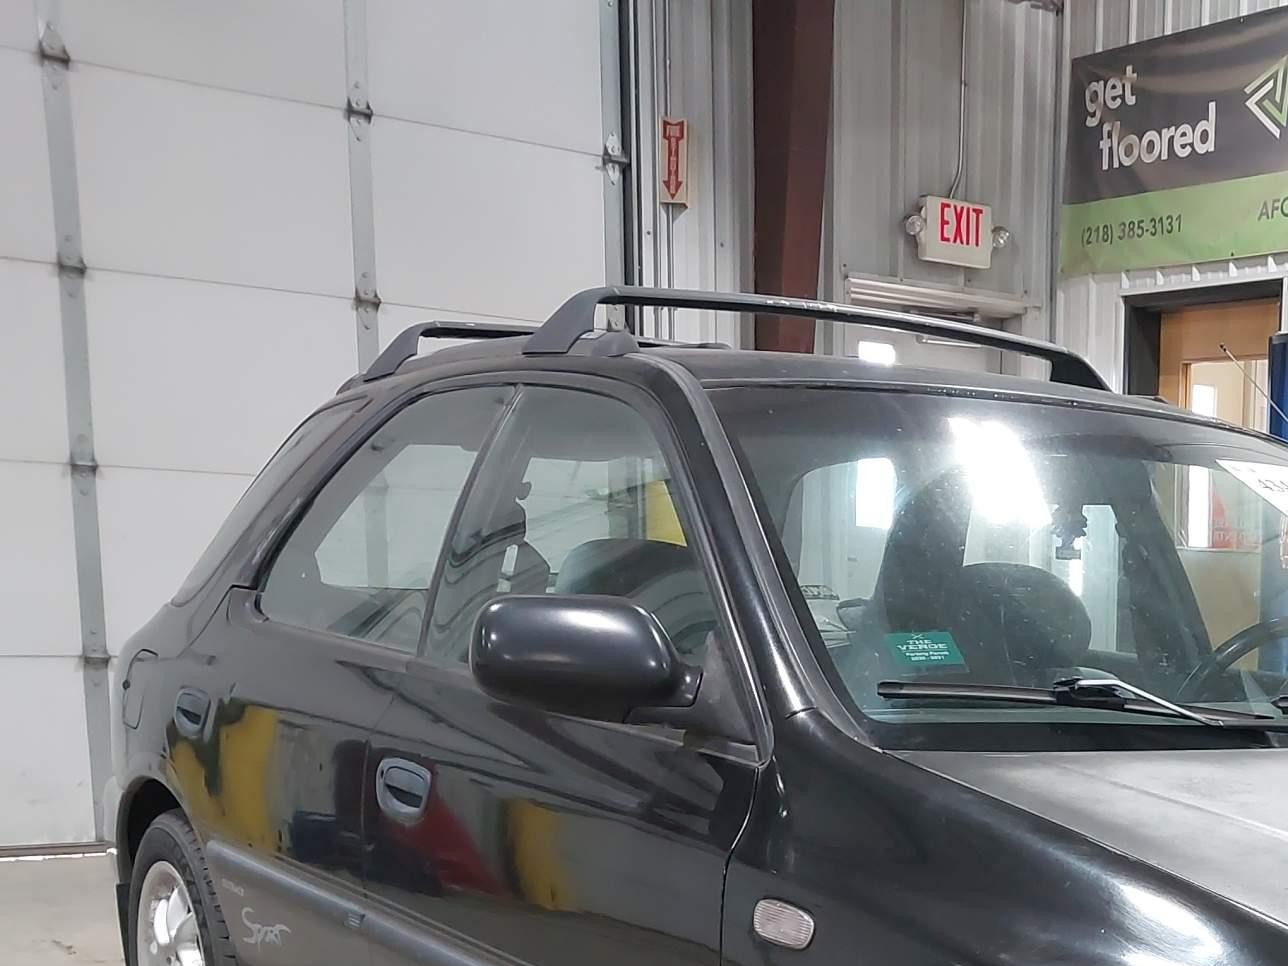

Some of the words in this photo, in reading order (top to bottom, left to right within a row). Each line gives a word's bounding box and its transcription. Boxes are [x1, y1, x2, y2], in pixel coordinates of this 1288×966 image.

[1085, 65, 1137, 127] get
[1100, 101, 1216, 170] floored
[941, 202, 983, 247] EXIT
[1082, 223, 1113, 247] (218)
[1118, 213, 1183, 242] 385-3131
